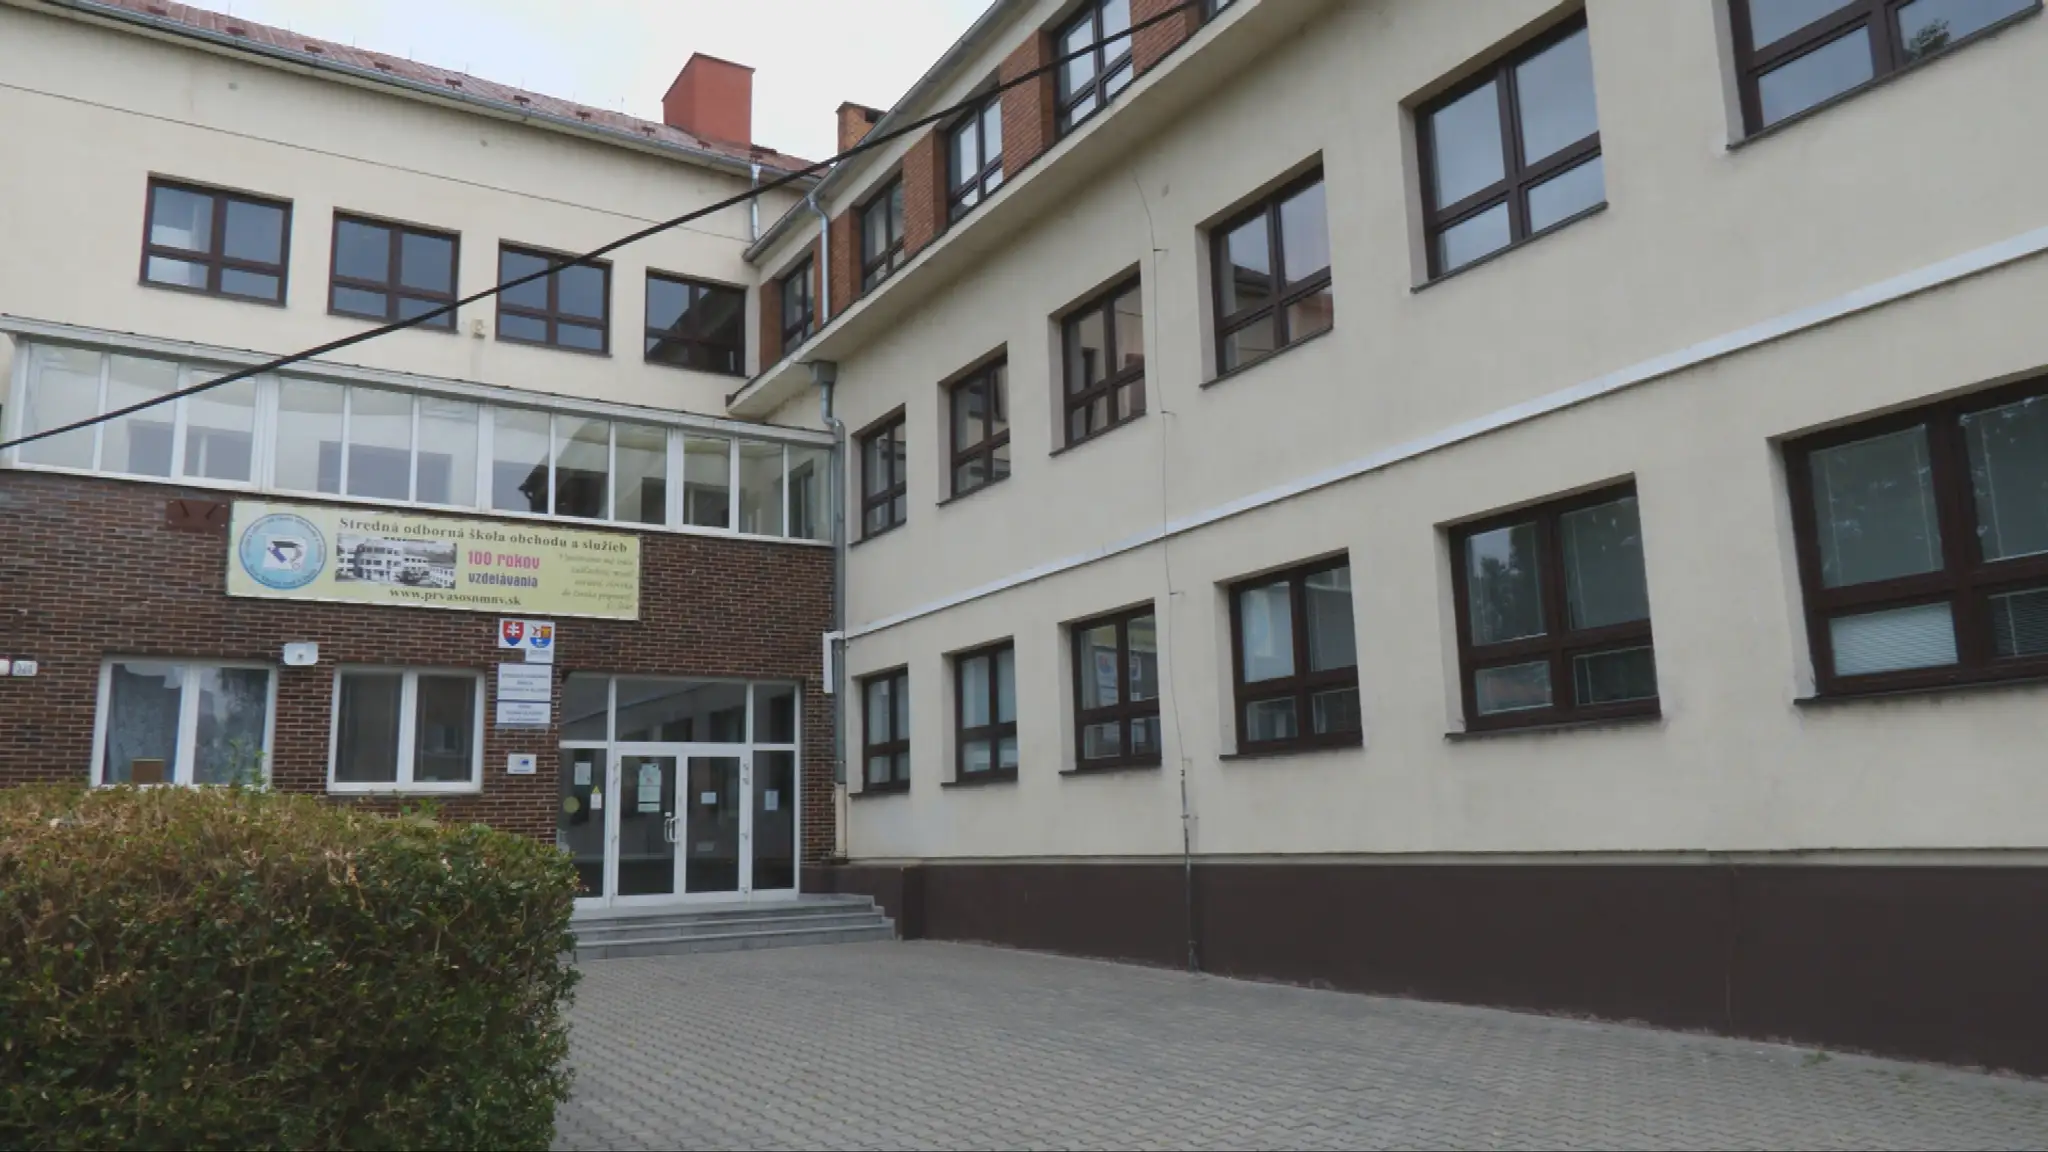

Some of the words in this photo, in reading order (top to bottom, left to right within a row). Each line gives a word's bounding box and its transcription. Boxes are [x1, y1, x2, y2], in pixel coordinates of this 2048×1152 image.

[339, 517, 400, 533] Stredná
[403, 523, 465, 539] odborná
[469, 528, 506, 543] škola
[510, 533, 567, 548] obchodu
[571, 539, 579, 548] a
[583, 538, 628, 553] služieb
[468, 549, 492, 566] 100
[497, 552, 541, 570] rokov
[468, 571, 539, 588] vzdelávania
